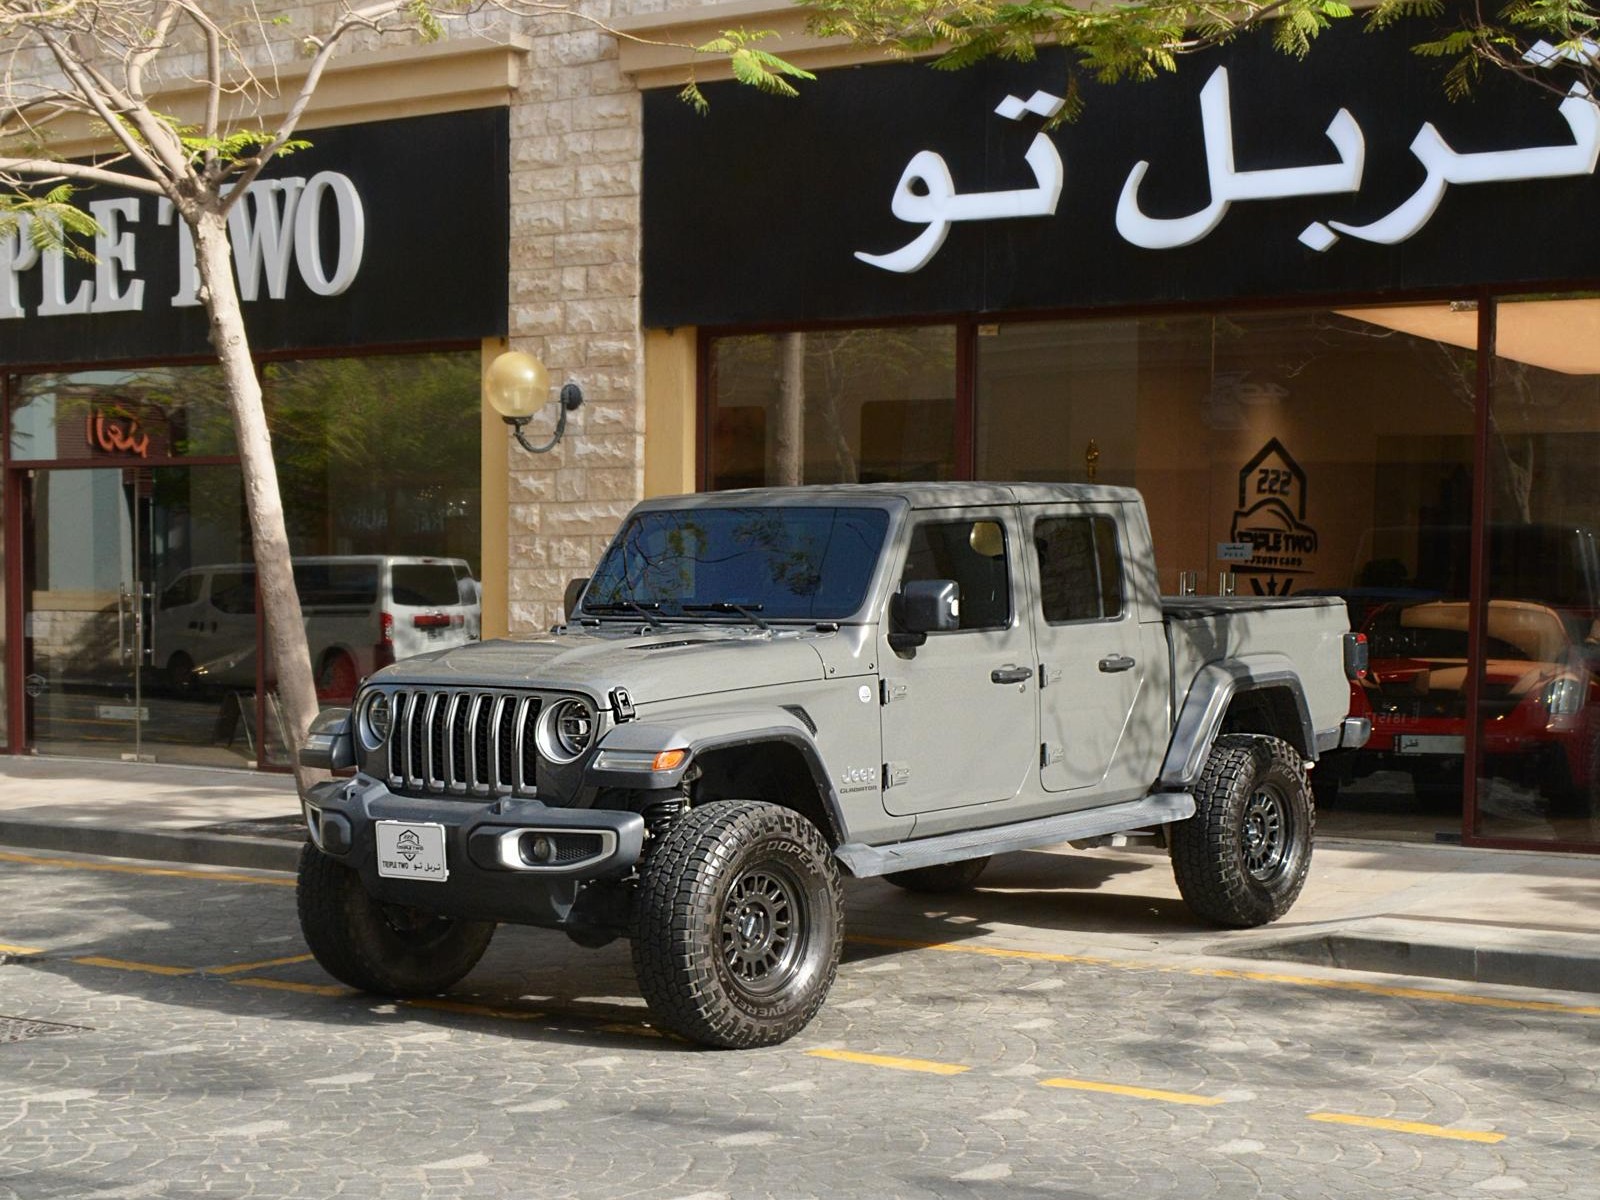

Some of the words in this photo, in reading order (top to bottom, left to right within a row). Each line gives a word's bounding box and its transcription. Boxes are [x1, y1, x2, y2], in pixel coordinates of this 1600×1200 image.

[854, 90, 1064, 273] تو
[1257, 469, 1292, 496] 222
[1285, 535, 1317, 553] TWO
[841, 765, 876, 785] Jeep
[755, 840, 819, 875] COOPER
